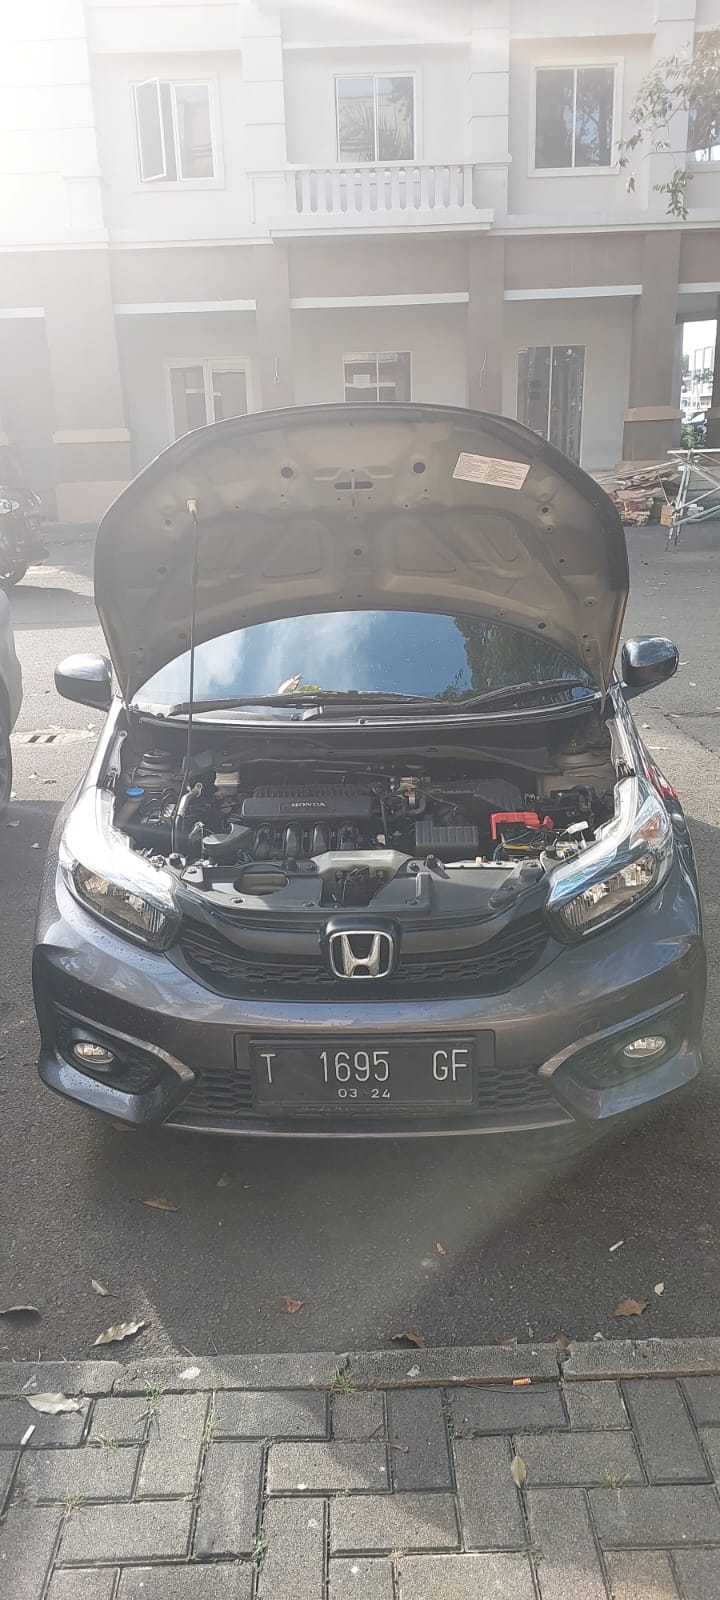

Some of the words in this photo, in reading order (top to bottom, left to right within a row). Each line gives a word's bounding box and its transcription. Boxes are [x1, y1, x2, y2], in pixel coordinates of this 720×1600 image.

[260, 1053, 276, 1084] T
[319, 1051, 389, 1083] 1695
[433, 1049, 468, 1081] GF
[337, 1088, 358, 1099] 03
[371, 1088, 391, 1099] 24
